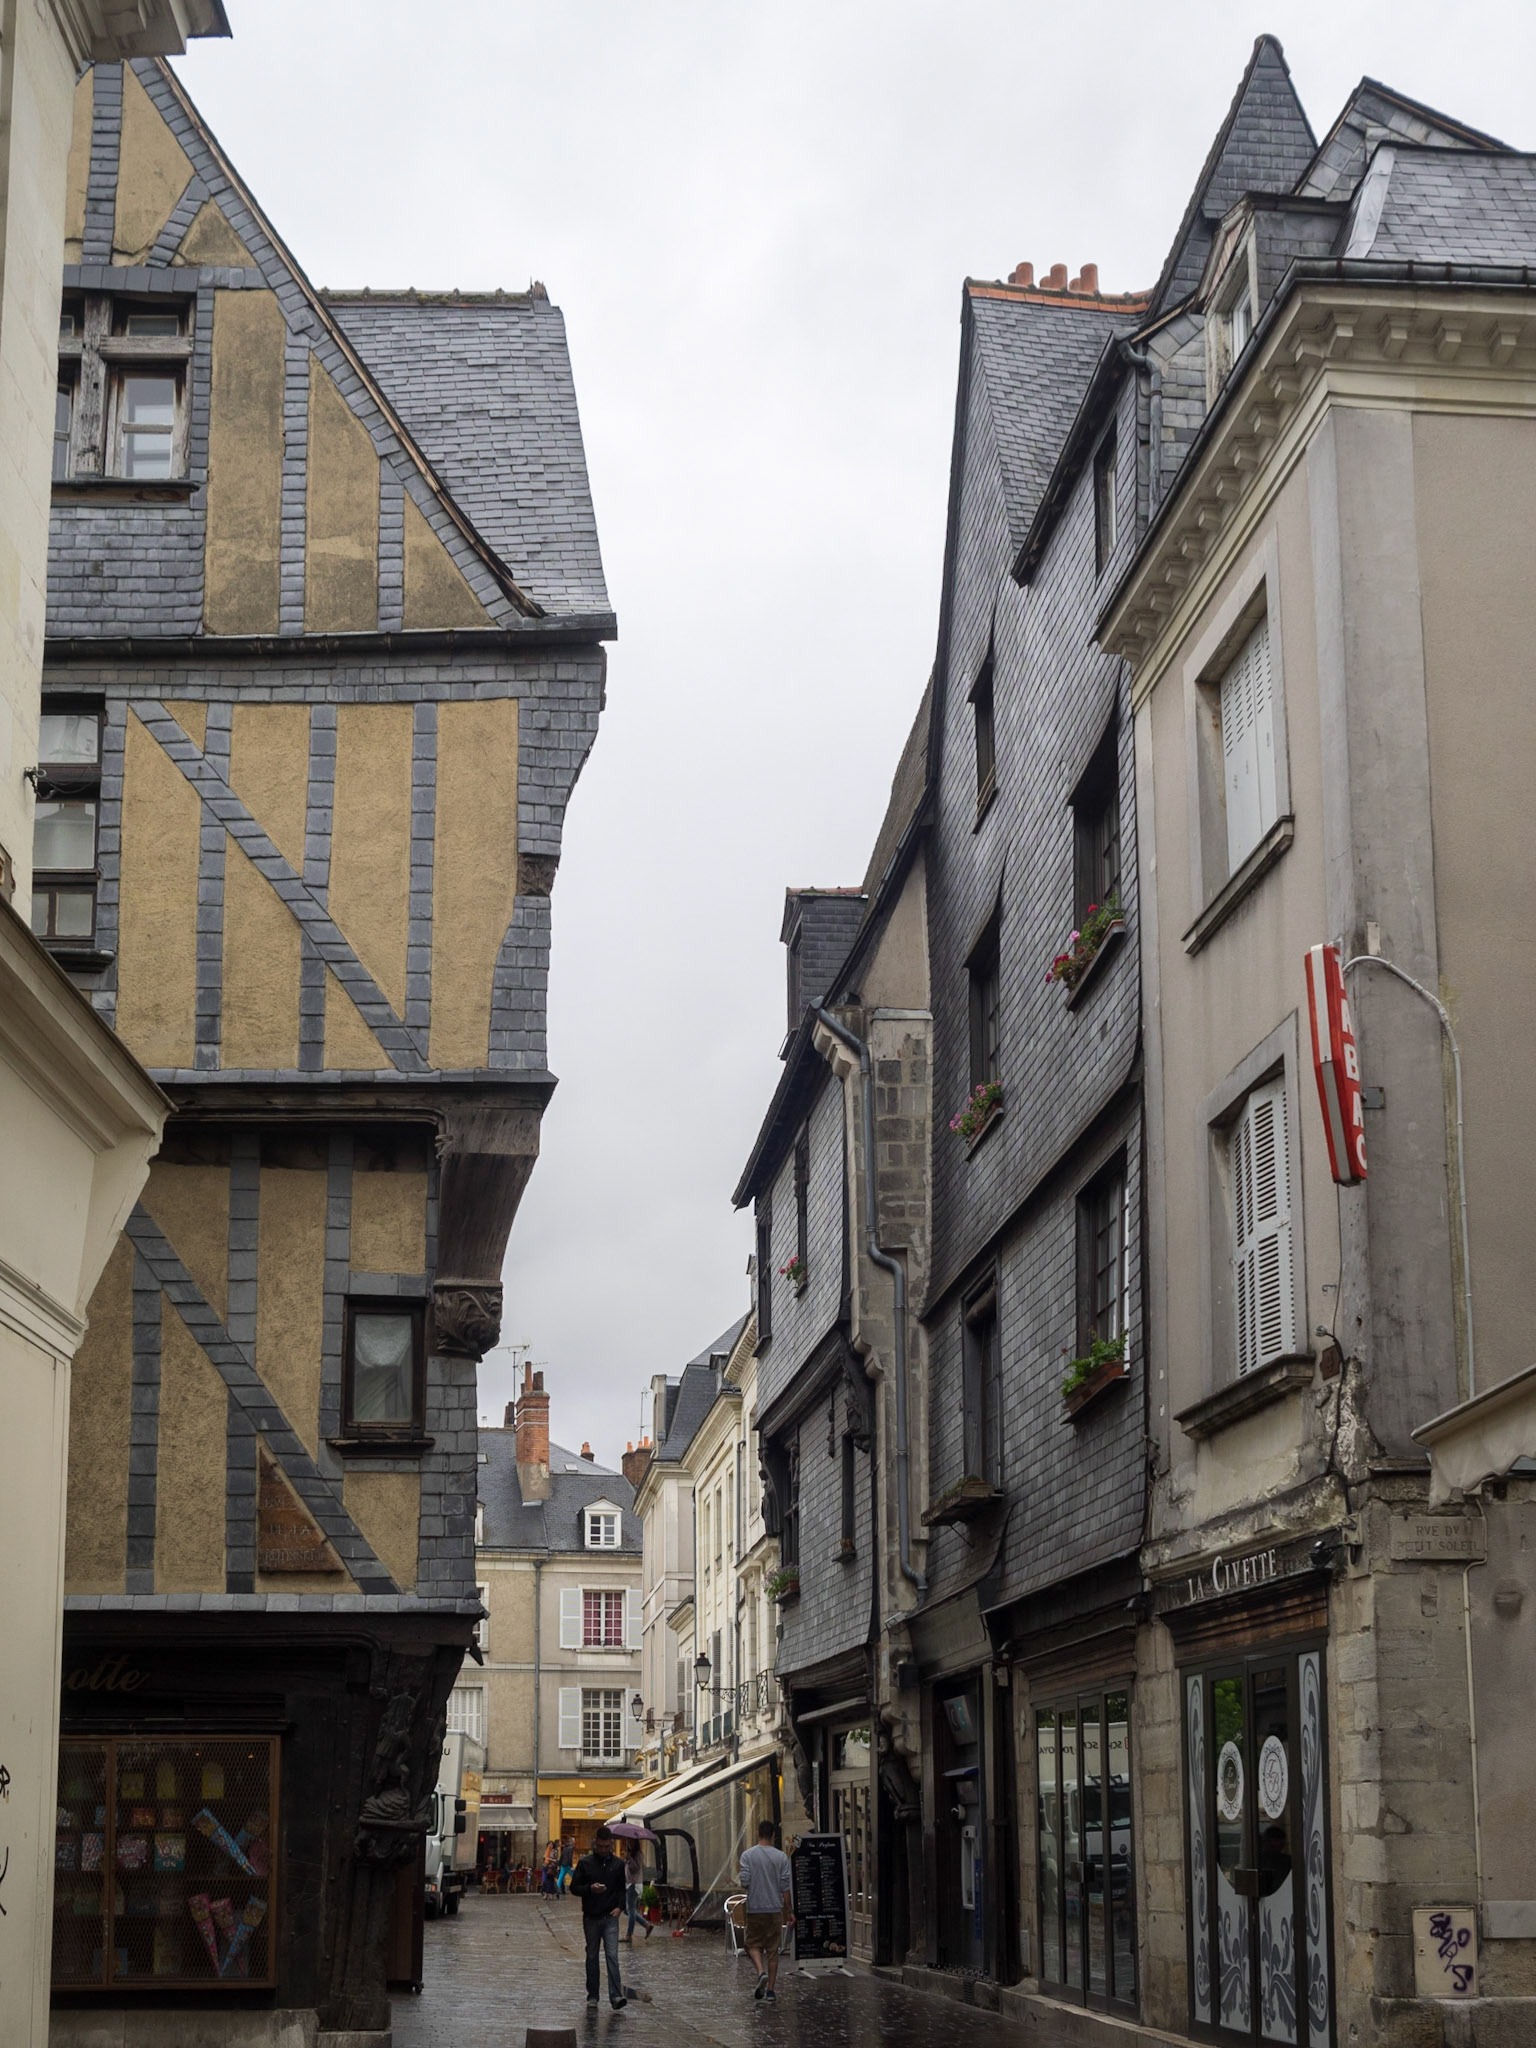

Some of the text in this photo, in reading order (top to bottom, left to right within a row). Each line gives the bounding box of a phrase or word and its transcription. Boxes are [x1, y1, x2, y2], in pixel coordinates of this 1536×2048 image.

[1334, 953, 1368, 1171] TABAC
[1415, 1525, 1441, 1537] RVE
[1439, 1541, 1481, 1552] SOLEIL
[1187, 1575, 1206, 1602] LA
[1212, 1548, 1277, 1593] CIVETTE
[63, 1655, 150, 1692] otte
